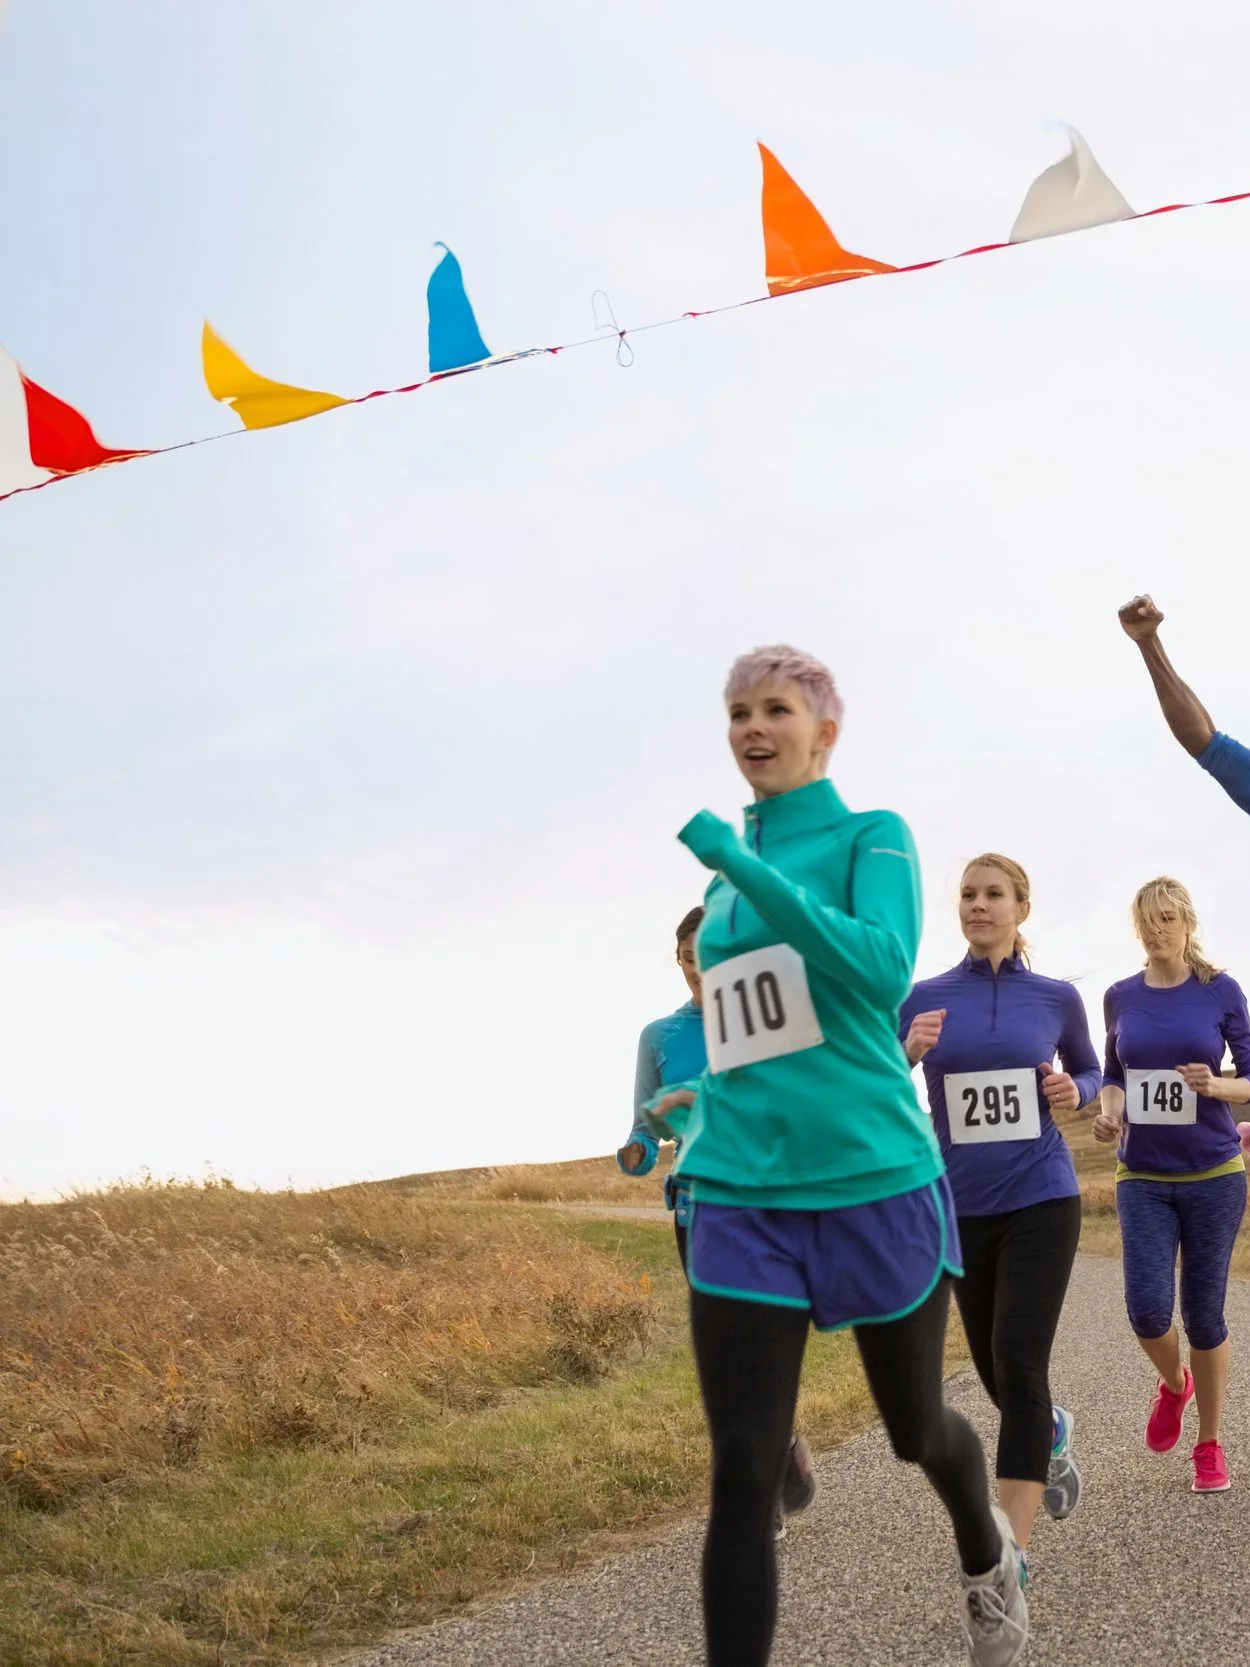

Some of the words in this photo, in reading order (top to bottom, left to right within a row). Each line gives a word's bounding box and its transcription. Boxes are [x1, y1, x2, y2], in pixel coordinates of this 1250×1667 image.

[713, 970, 786, 1044] 110
[962, 1084, 1021, 1127] 295
[1140, 1081, 1183, 1113] 148
